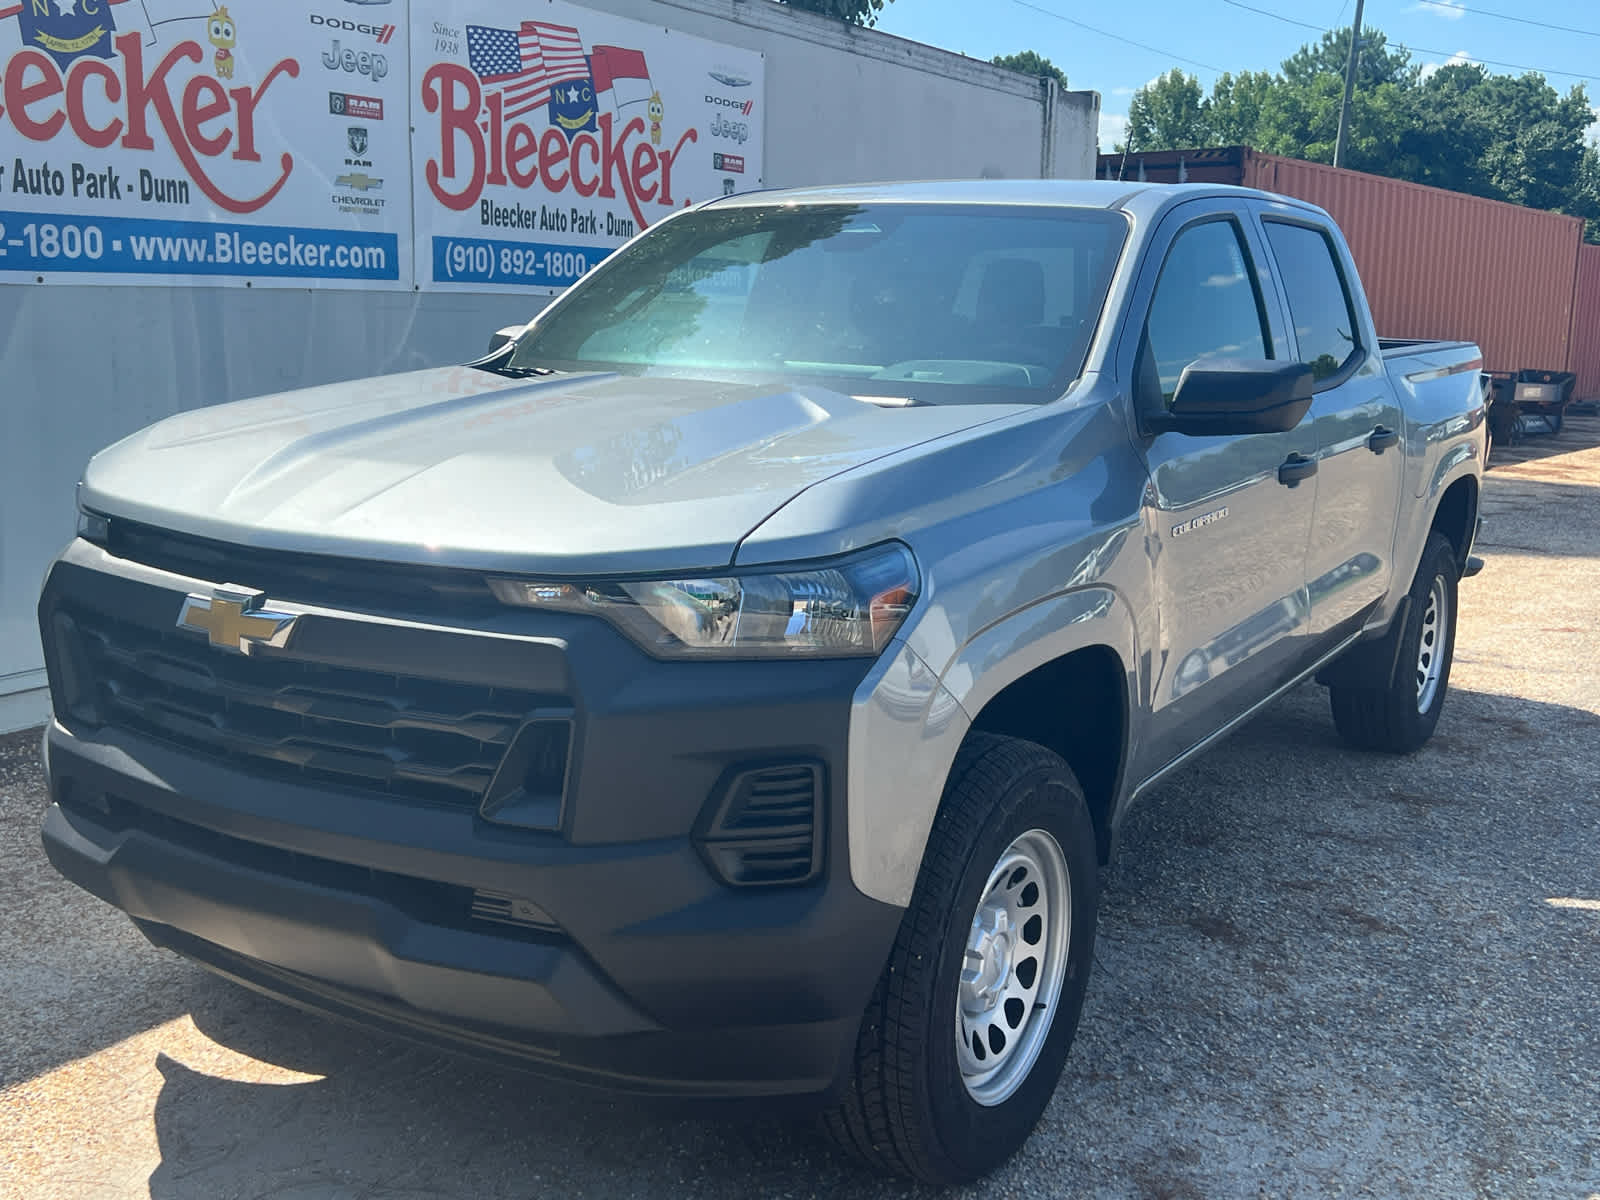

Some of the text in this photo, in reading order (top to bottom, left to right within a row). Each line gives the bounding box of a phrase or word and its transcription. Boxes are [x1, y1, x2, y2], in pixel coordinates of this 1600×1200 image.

[310, 14, 385, 37] DODGE
[432, 22, 460, 38] Since
[322, 39, 388, 82] Jeep
[434, 39, 458, 55] 1938
[348, 99, 380, 110] RAM
[555, 86, 592, 105] N C
[704, 95, 746, 110] DODGE
[0, 32, 299, 213] ecker
[710, 112, 749, 145] Jeep
[421, 62, 698, 231] Bleecker
[344, 158, 372, 168] RAM
[12, 158, 64, 196] Auto
[72, 163, 121, 200] Park
[140, 168, 190, 204] Dunn
[331, 195, 386, 208] CHEVROLET
[481, 199, 634, 238] Bleecker Auto Park Dunn
[129, 232, 385, 268] www.Bleecker.com
[445, 242, 586, 279] (910) 892-1800
